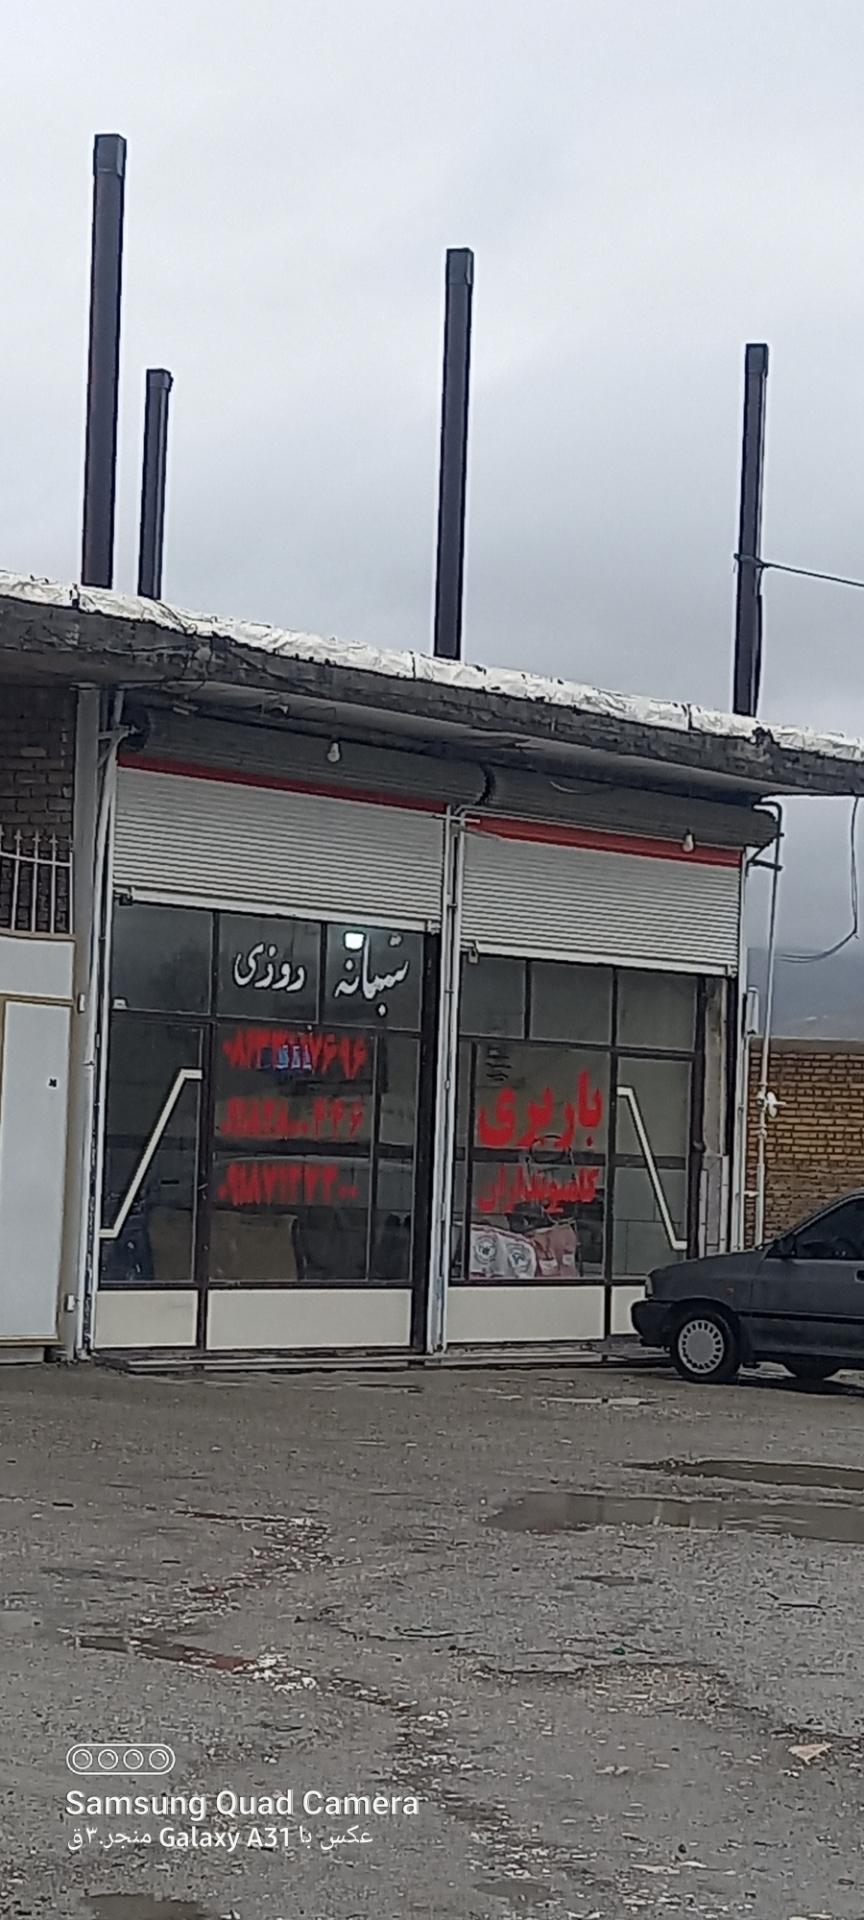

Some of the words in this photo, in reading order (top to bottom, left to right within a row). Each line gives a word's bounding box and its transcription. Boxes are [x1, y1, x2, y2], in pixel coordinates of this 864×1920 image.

[234, 943, 304, 992] روزی
[334, 933, 409, 1016] شبانه
[478, 1069, 602, 1149] باربری
